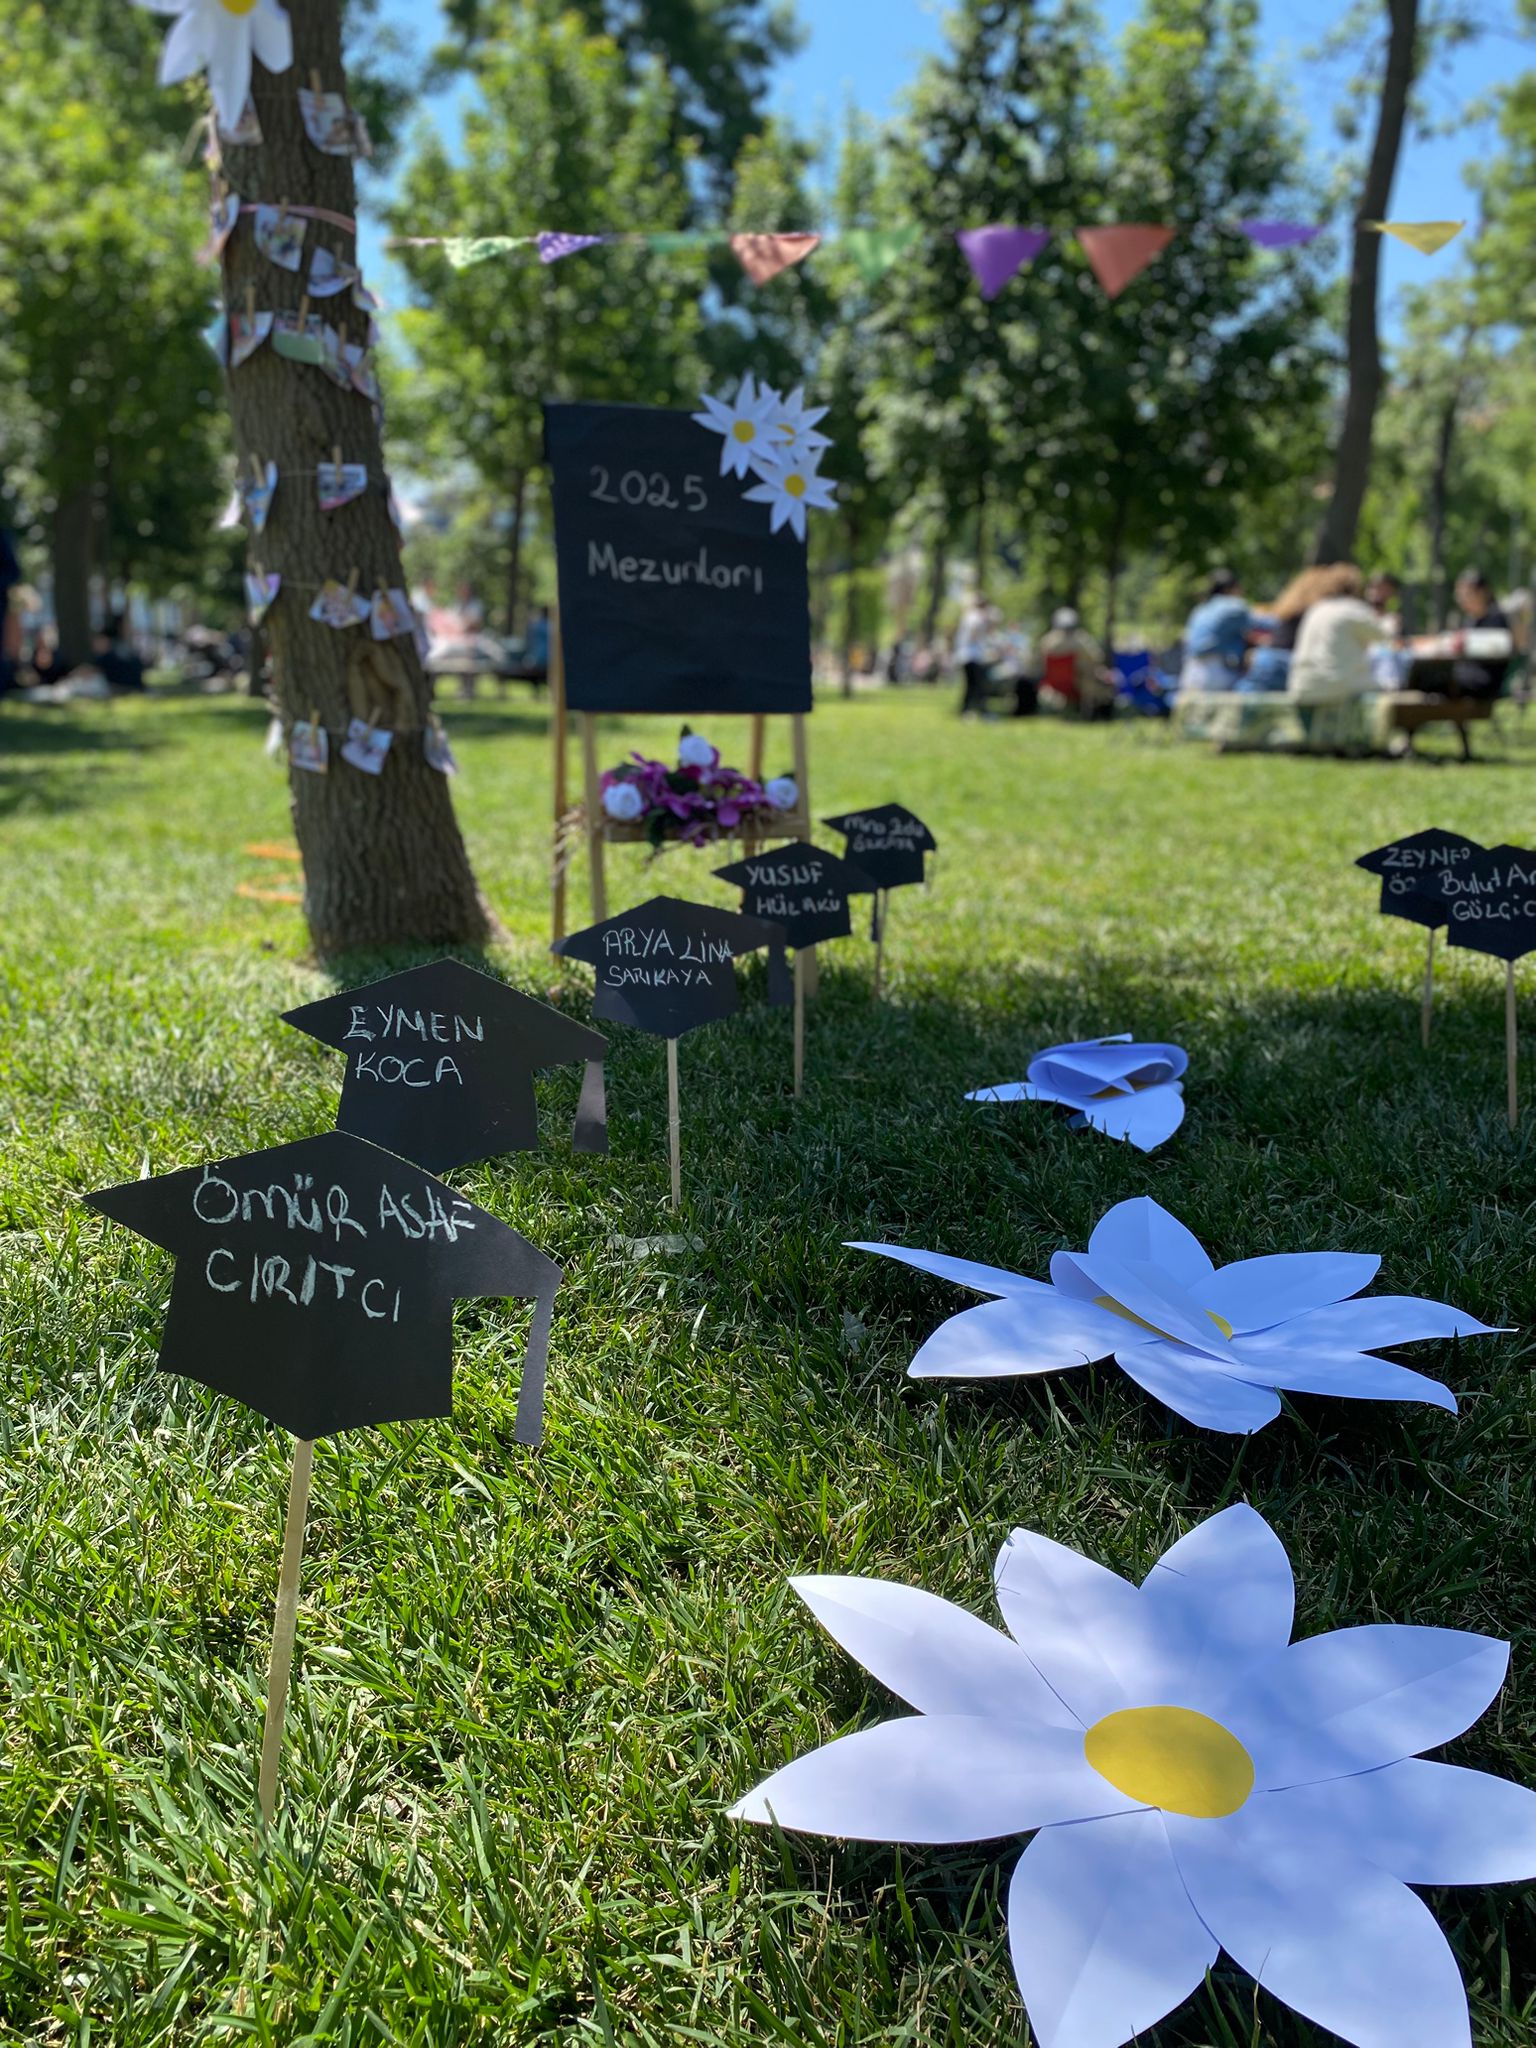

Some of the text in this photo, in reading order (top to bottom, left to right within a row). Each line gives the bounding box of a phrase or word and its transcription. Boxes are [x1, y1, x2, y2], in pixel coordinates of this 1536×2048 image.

[590, 464, 708, 512] 2025
[745, 861, 823, 886] YUSUF
[1438, 867, 1501, 896] Bulut
[602, 928, 675, 958] ARYA
[603, 965, 713, 987] SARIKAYA
[342, 1004, 485, 1043] EYMEN
[354, 1051, 464, 1088] KOCA
